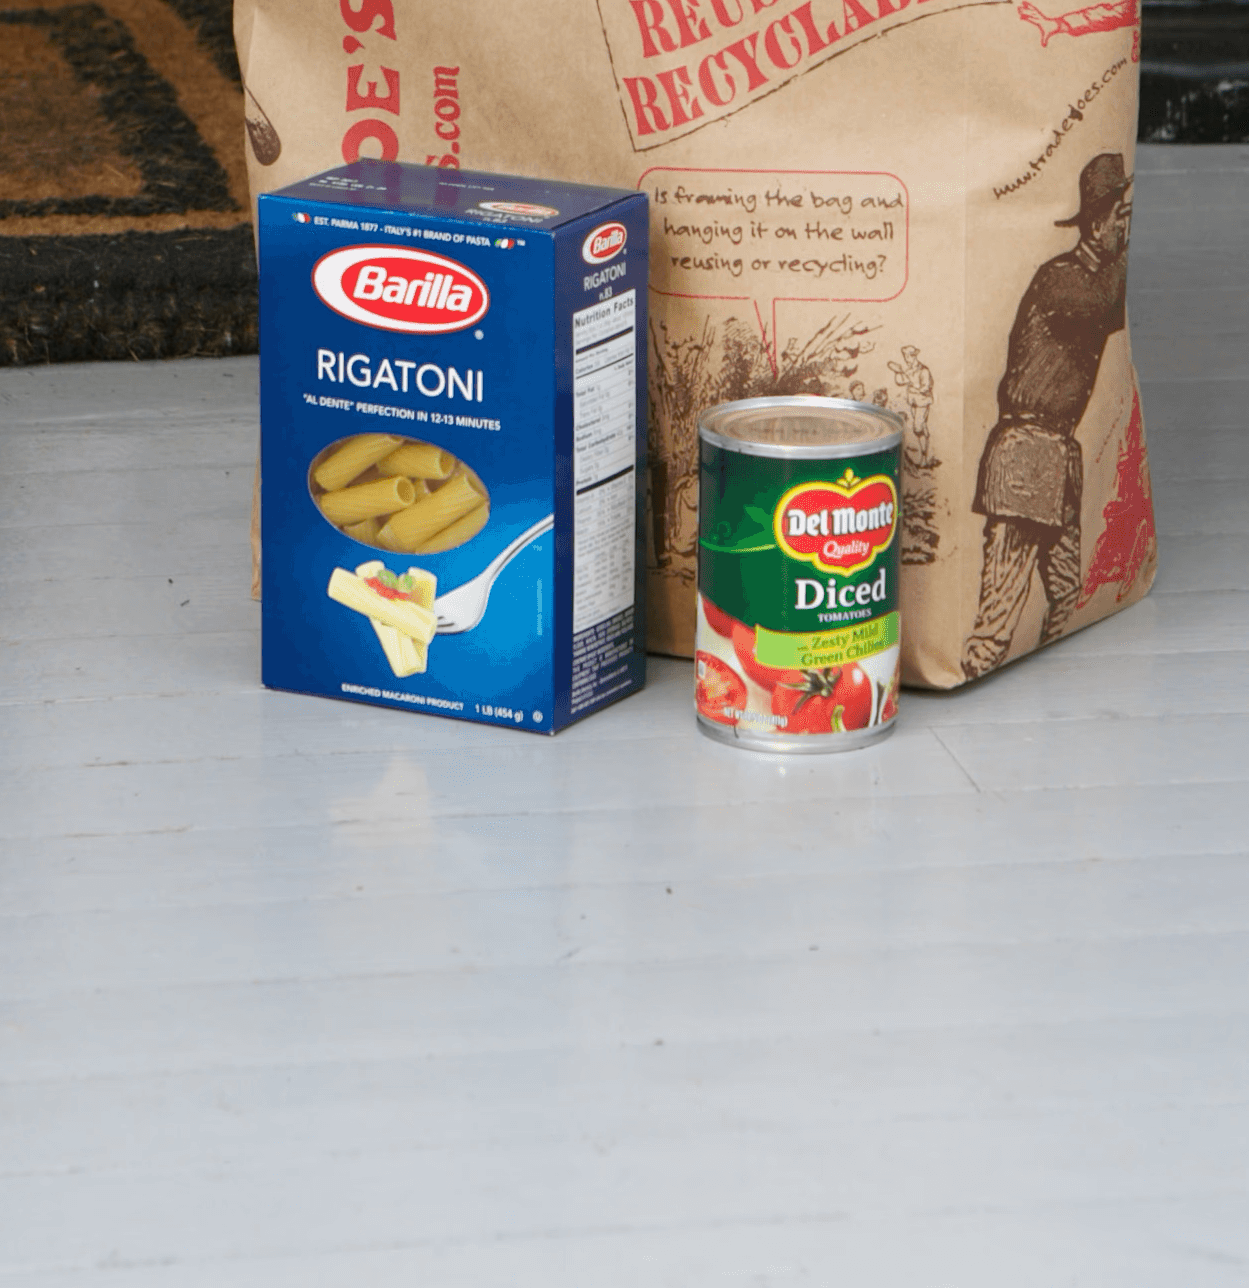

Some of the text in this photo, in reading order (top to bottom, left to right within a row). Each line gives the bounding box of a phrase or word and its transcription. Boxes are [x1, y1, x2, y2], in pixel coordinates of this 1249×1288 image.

[654, 185, 905, 216] Is framing the bag and
[313, 215, 330, 227] EST.
[330, 217, 359, 231] PARMA
[359, 221, 379, 233] 1877
[383, 224, 412, 238] ITALY'S
[422, 229, 452, 243] BRAND
[452, 233, 465, 244] OF
[465, 235, 492, 247] PASTA
[592, 228, 624, 256] Barilla
[663, 217, 895, 245] hanging it on the wall
[582, 261, 627, 292] RIGATONI
[670, 252, 888, 280] reusing or recycling?
[352, 265, 473, 313] Barilla
[574, 296, 634, 330] Nutrition Facts
[317, 348, 484, 403] RIGATONI
[355, 402, 415, 421] PERFECTION
[416, 411, 428, 423] IN
[430, 413, 454, 426] 12-13
[454, 415, 502, 432] MINUTES
[787, 501, 894, 537] Del Monte
[823, 540, 870, 559] Quality
[794, 567, 887, 610] Diced
[817, 608, 872, 623] TOMATOES
[810, 632, 850, 651] Zesty
[852, 622, 880, 643] Mild
[801, 651, 844, 667] Green
[340, 682, 464, 712] ENRICHED MACARONI PRODUCT
[481, 705, 493, 716] LB
[493, 706, 514, 720] (454
[513, 709, 524, 723] g)
